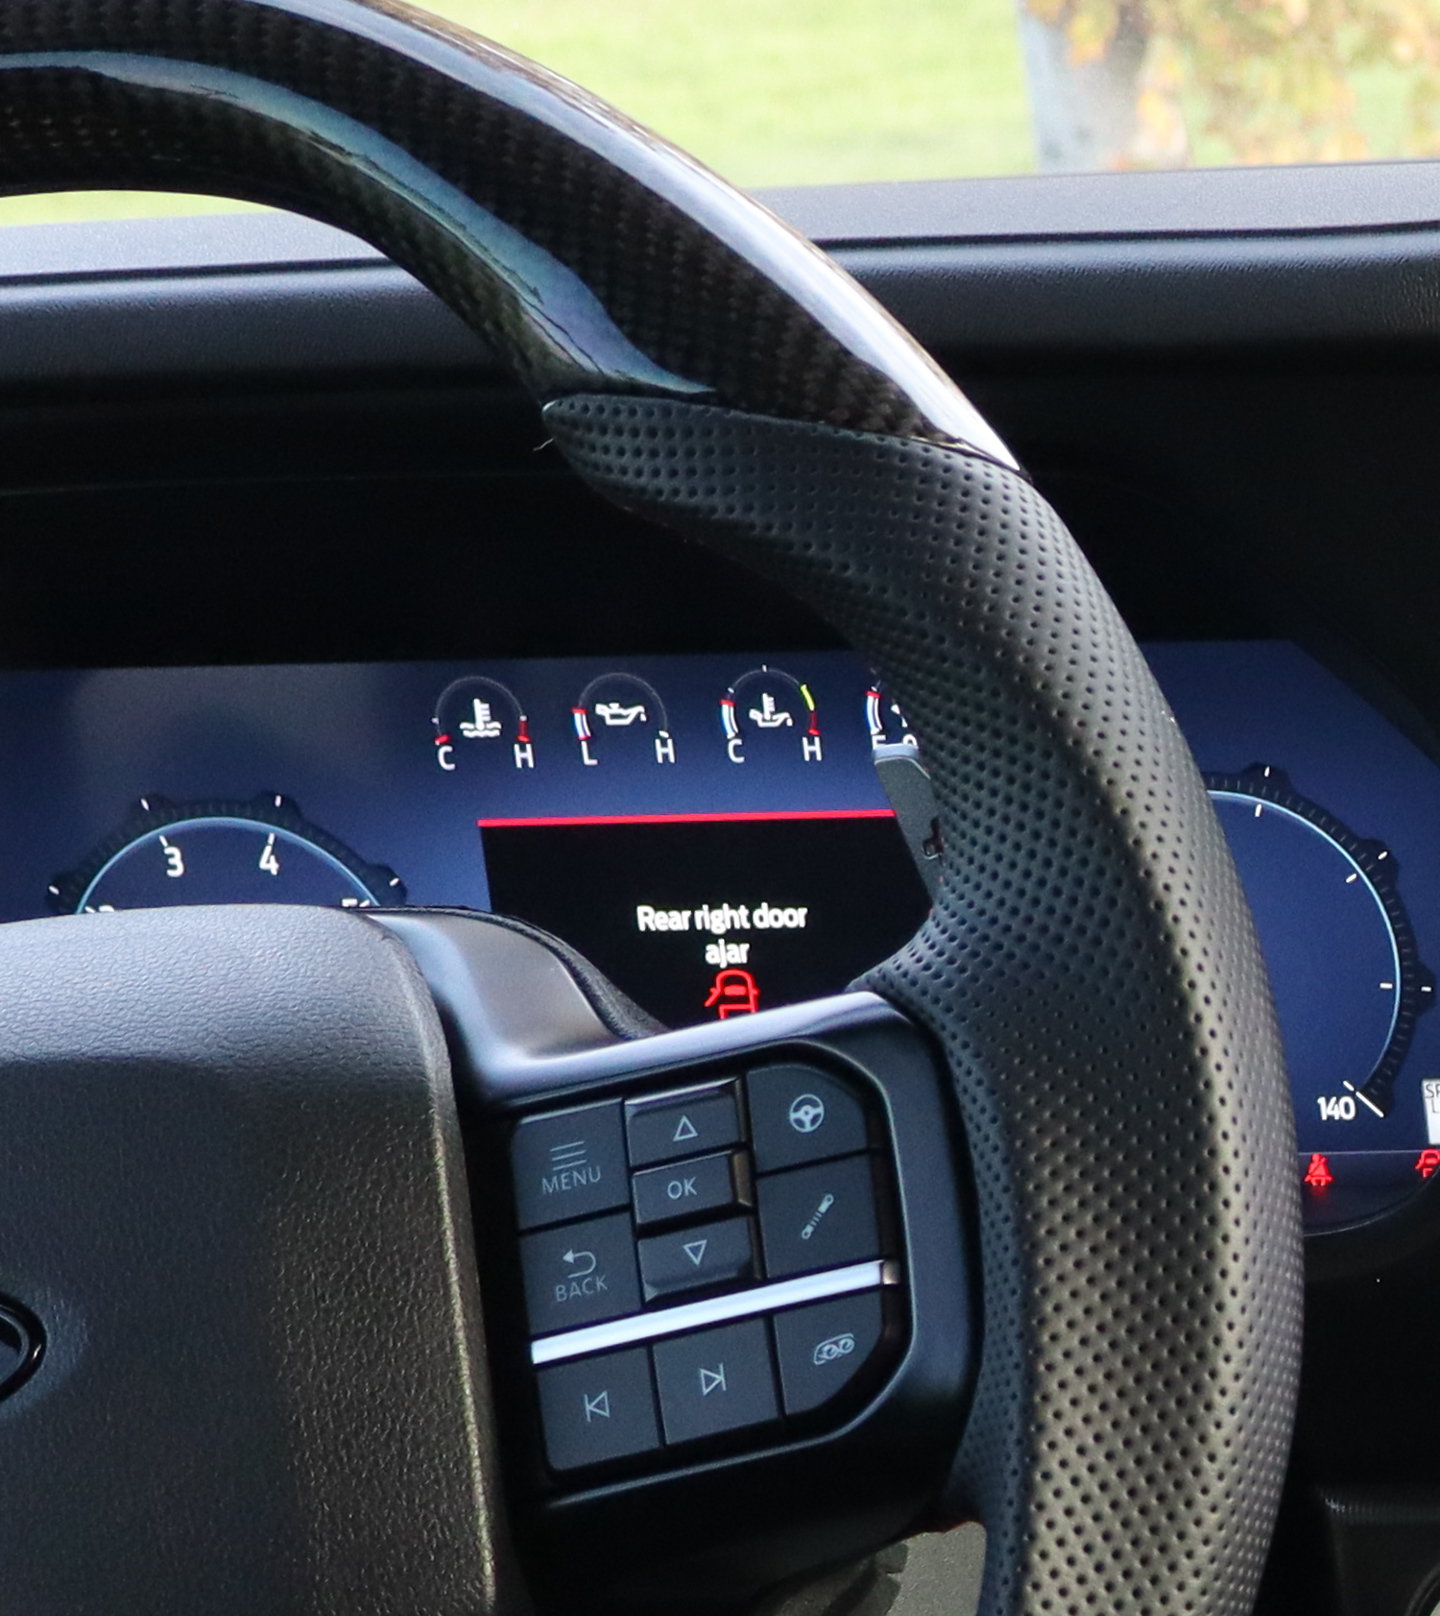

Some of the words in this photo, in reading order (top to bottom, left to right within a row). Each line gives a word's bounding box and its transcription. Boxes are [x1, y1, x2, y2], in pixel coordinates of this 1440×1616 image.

[438, 745, 457, 770] C
[514, 743, 534, 768] H
[581, 741, 598, 766] L
[655, 739, 676, 764] H
[727, 738, 746, 763] C
[803, 736, 823, 761] H
[163, 846, 185, 878] 3
[258, 844, 280, 875] 4
[636, 905, 691, 931] Rear
[695, 903, 750, 934] right
[752, 902, 808, 929] door
[704, 938, 750, 968] ajar
[1317, 1096, 1356, 1121] 140
[540, 1165, 602, 1196] MENU
[666, 1176, 698, 1200] OK
[555, 1275, 609, 1302] BACK
